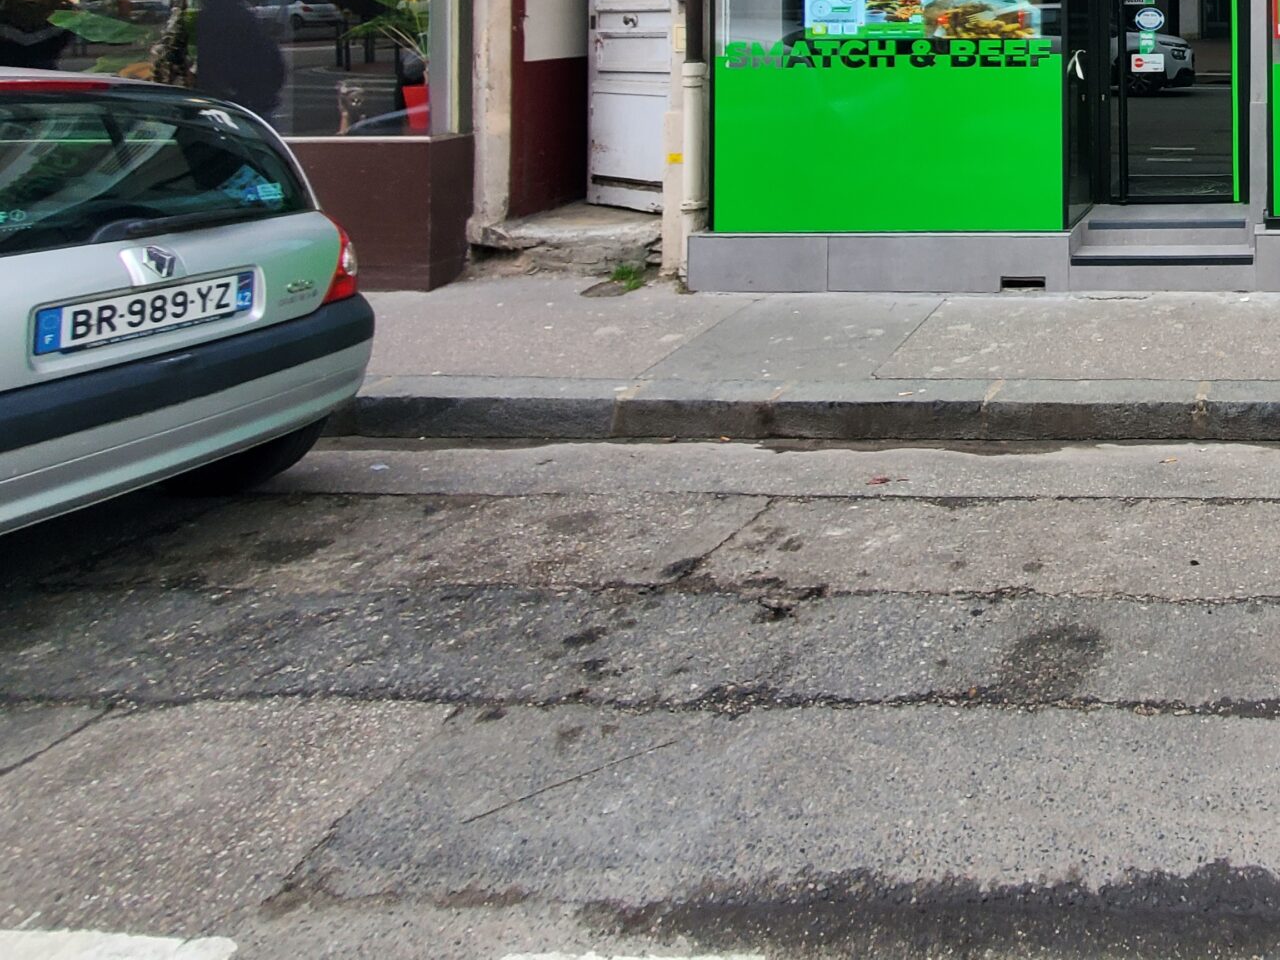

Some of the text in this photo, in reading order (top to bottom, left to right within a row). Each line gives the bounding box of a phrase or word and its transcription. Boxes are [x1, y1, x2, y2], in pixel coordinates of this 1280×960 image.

[724, 40, 1052, 68] SMATCH & BEEF
[70, 282, 231, 341] BR-989-YZ
[44, 334, 54, 344] F
